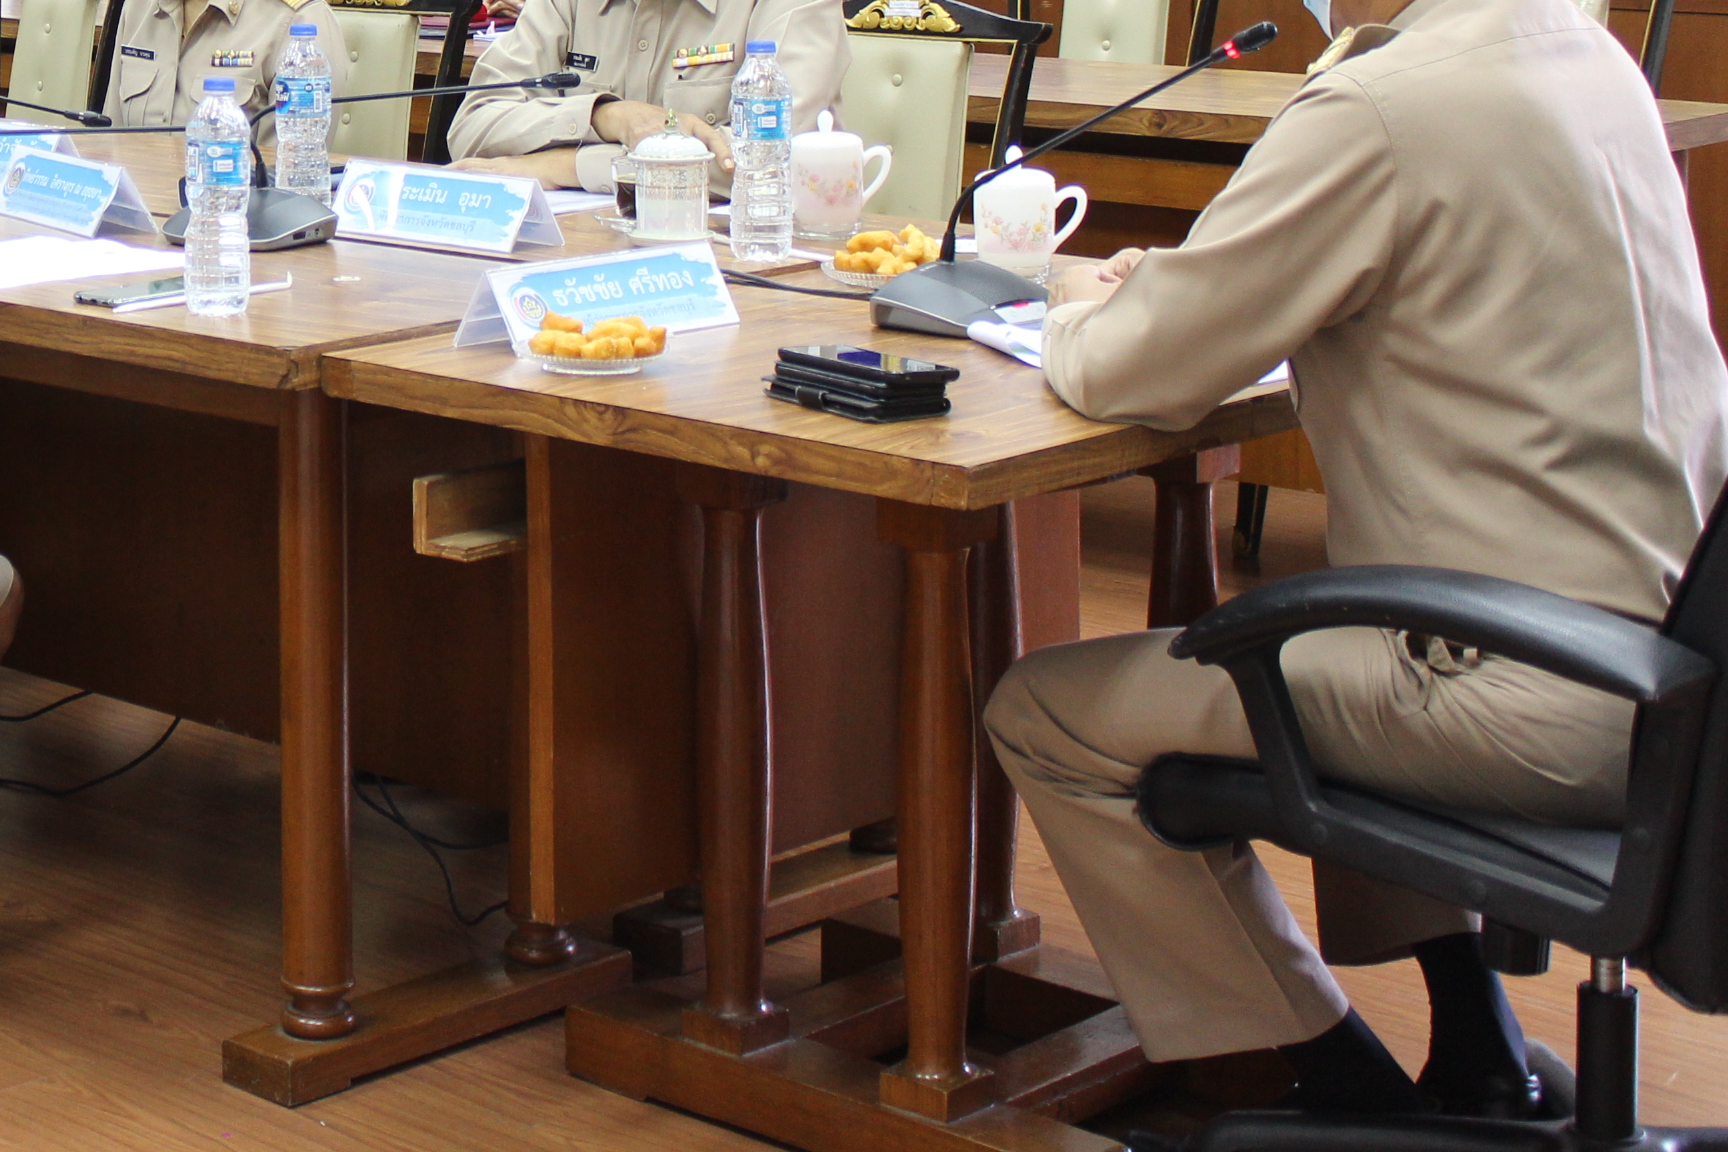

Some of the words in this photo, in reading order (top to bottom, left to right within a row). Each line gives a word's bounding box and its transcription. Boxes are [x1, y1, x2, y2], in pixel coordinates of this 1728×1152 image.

[458, 191, 492, 212] อุมา
[553, 273, 623, 307] ธวัชชัย
[629, 266, 695, 296] ศรีทอง
